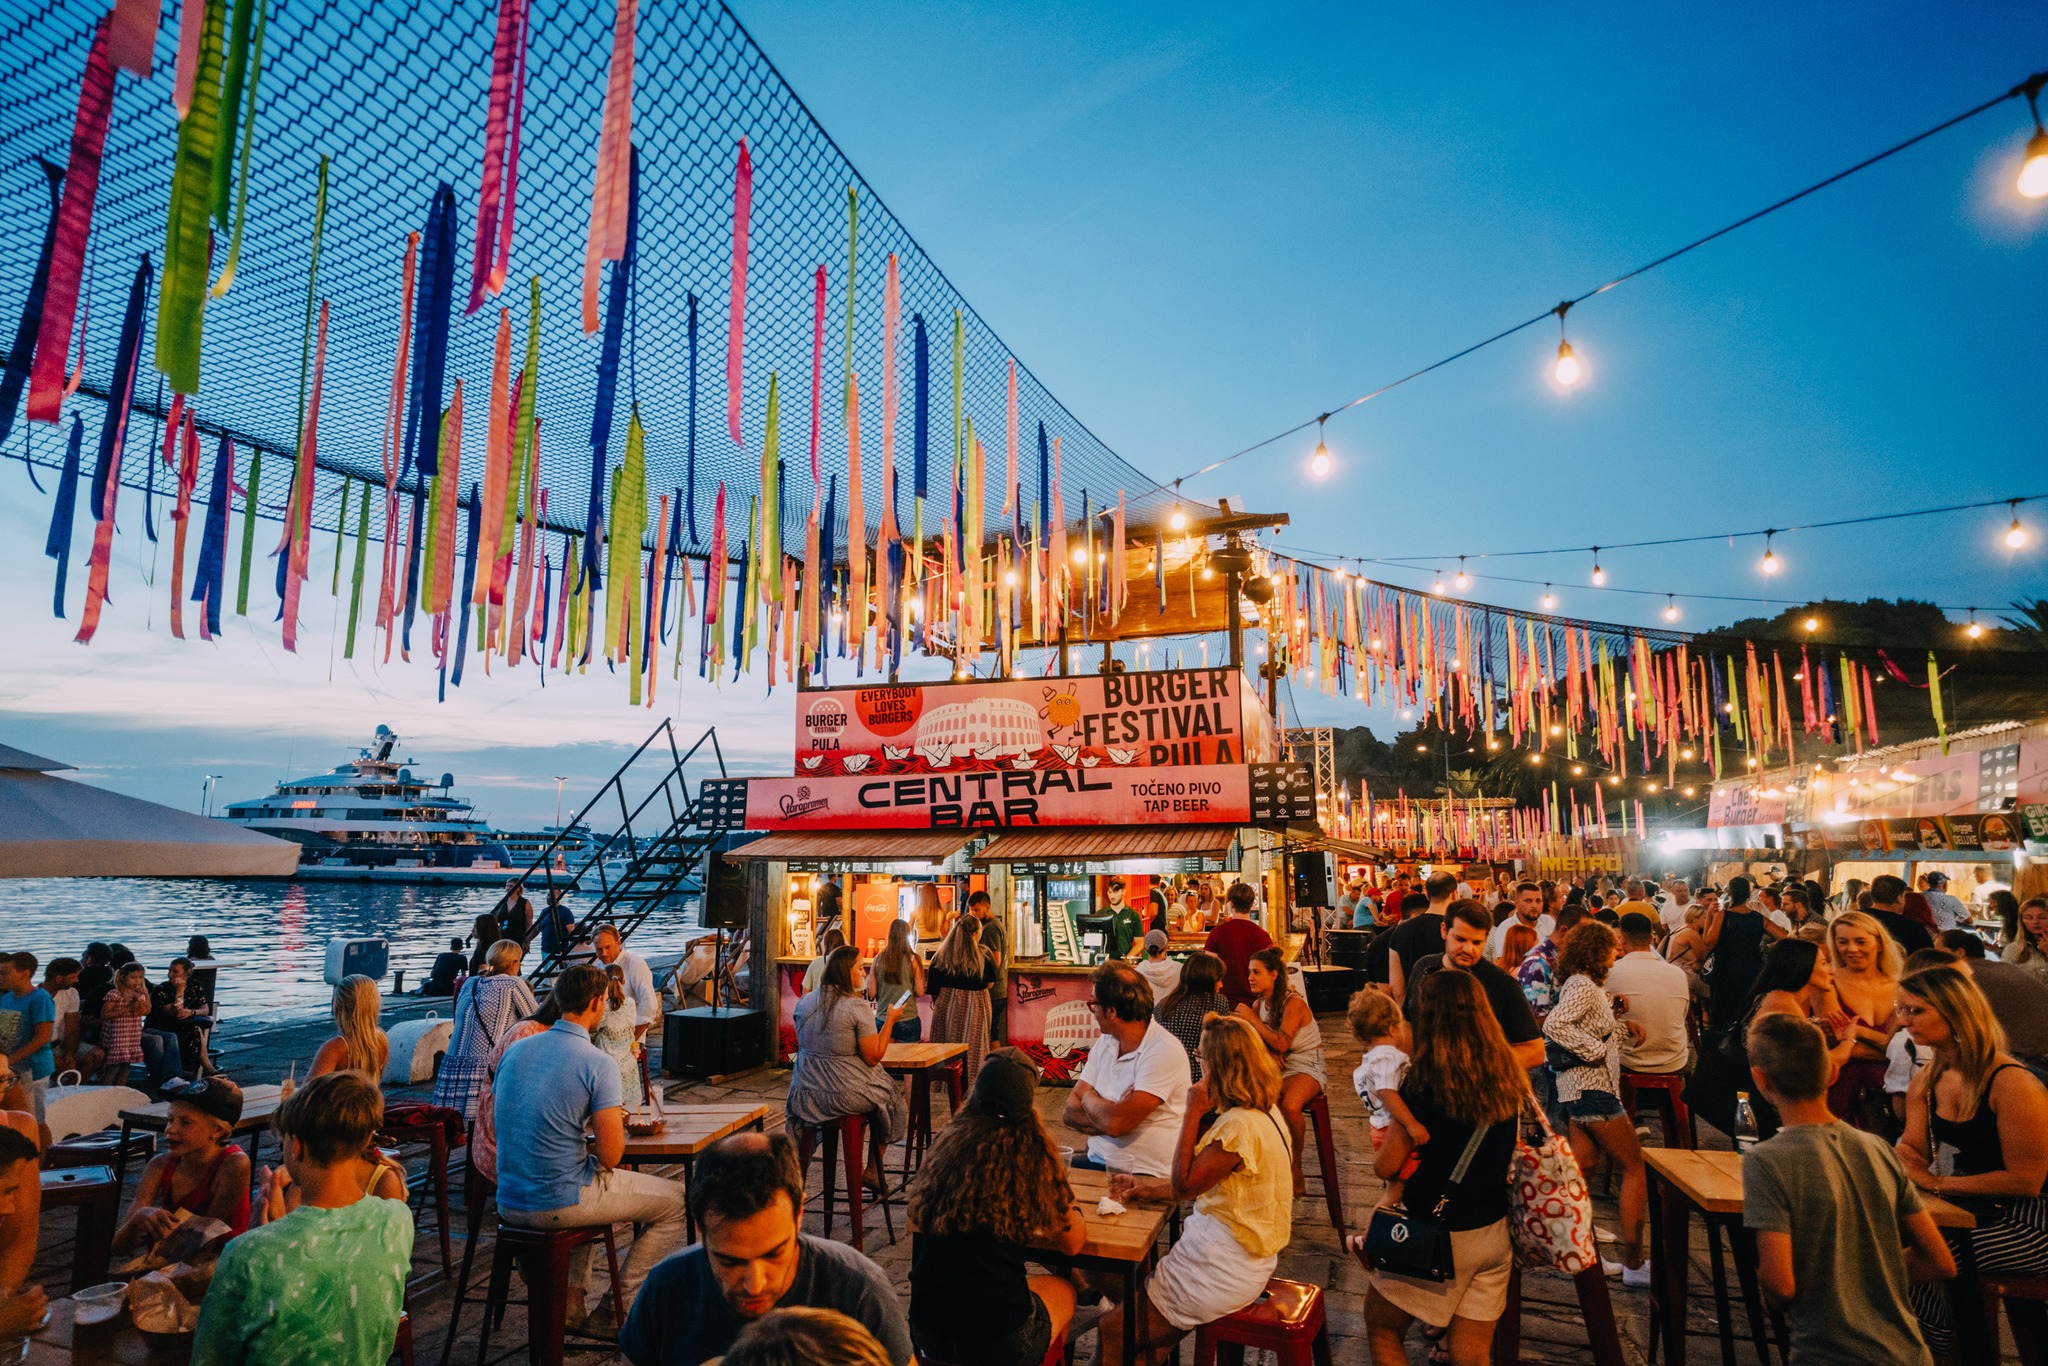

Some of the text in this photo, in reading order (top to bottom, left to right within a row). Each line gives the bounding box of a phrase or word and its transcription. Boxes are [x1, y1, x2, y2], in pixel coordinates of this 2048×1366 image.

[861, 687, 917, 702] EVERYBODY
[1102, 671, 1230, 708] BURGER
[874, 700, 906, 713] LOVES
[805, 713, 847, 727] BURGER
[869, 711, 913, 726] BURGERS
[1083, 702, 1233, 746] FESTIVAL
[811, 738, 840, 751] PULA
[1150, 738, 1234, 766] PULA
[858, 769, 1112, 809] CENTRAL
[1131, 778, 1222, 796] TOČENO PIVO
[779, 794, 830, 821] Staropramen
[930, 797, 1040, 828] BAR
[1143, 799, 1209, 812] TAP BEER
[1723, 805, 1758, 826] Burger
[1949, 822, 1974, 834] Veggie
[1952, 834, 1979, 845] DELUXE
[1541, 855, 1623, 872] METRO
